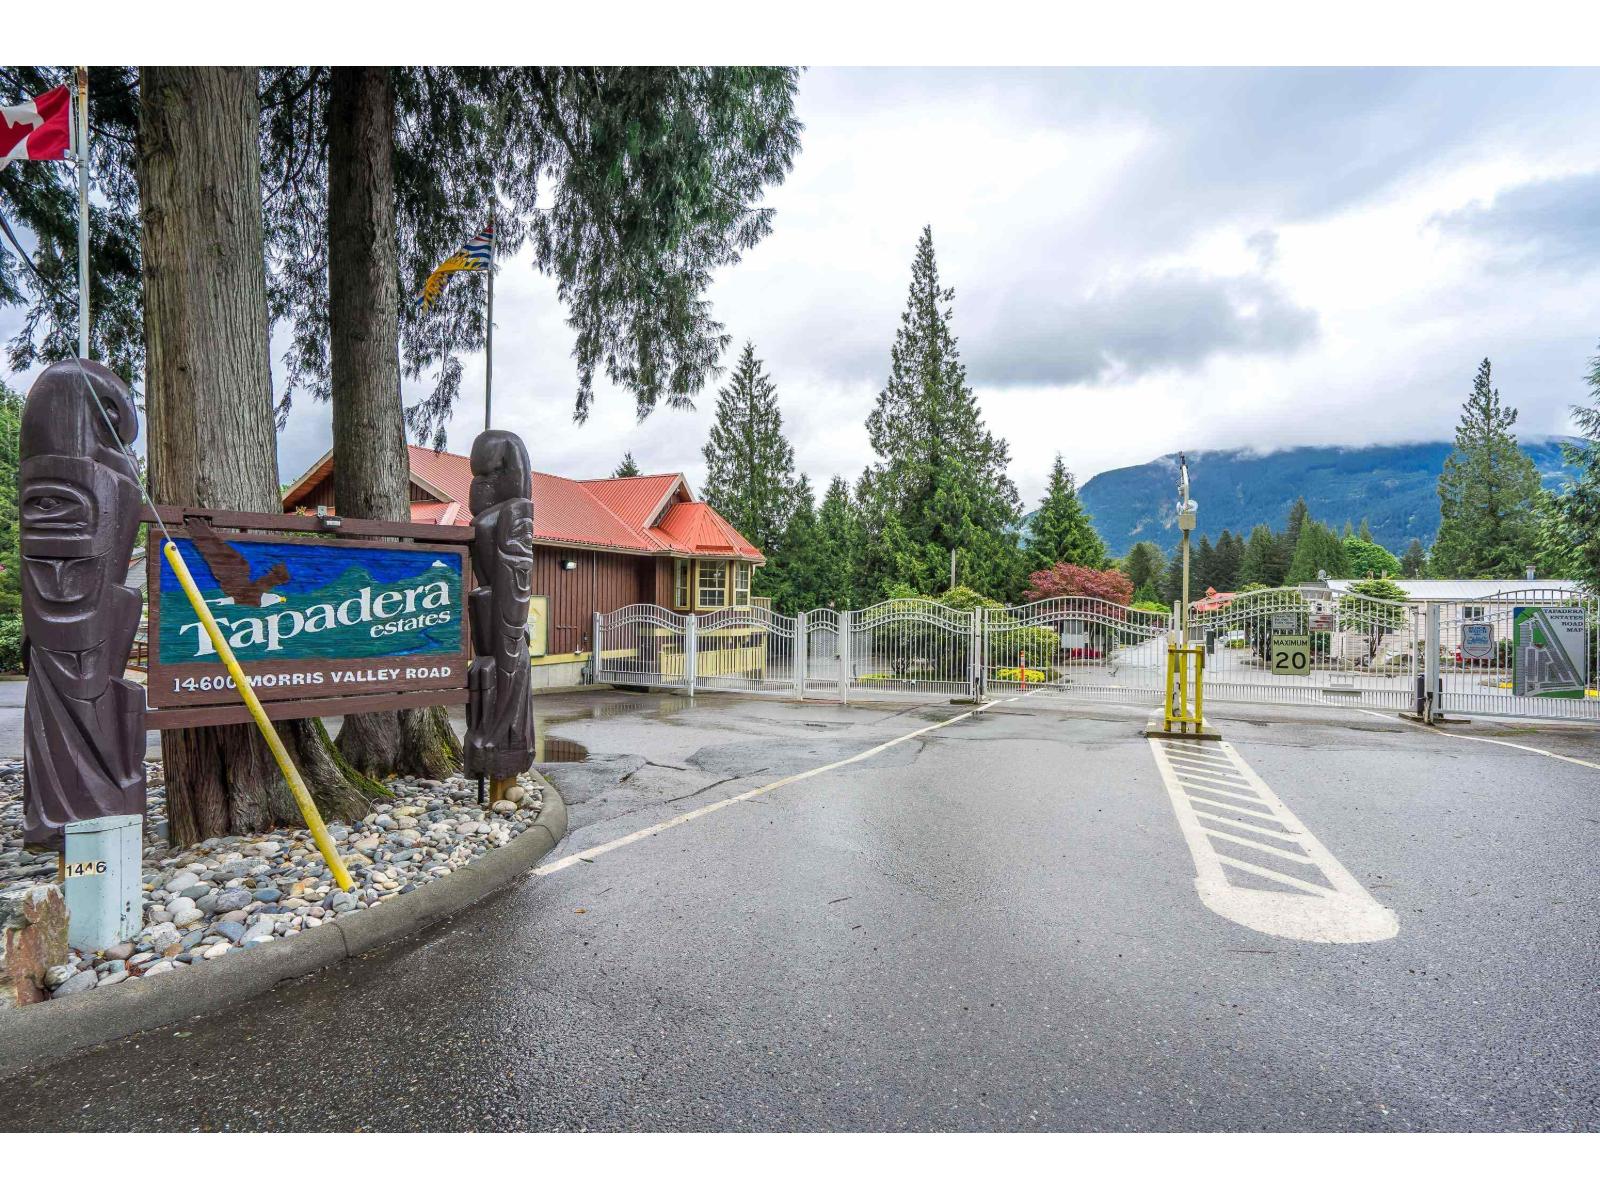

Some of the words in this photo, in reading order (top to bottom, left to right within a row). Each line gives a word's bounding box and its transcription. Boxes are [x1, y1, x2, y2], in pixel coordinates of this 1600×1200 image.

[179, 581, 451, 657] Tapadera
[370, 610, 451, 638] estates
[1273, 639, 1308, 647] MAXIMUM
[1275, 651, 1307, 670] 20
[245, 672, 324, 688] MORRIS
[331, 669, 401, 684] VALLEY
[405, 666, 452, 680] ROAD
